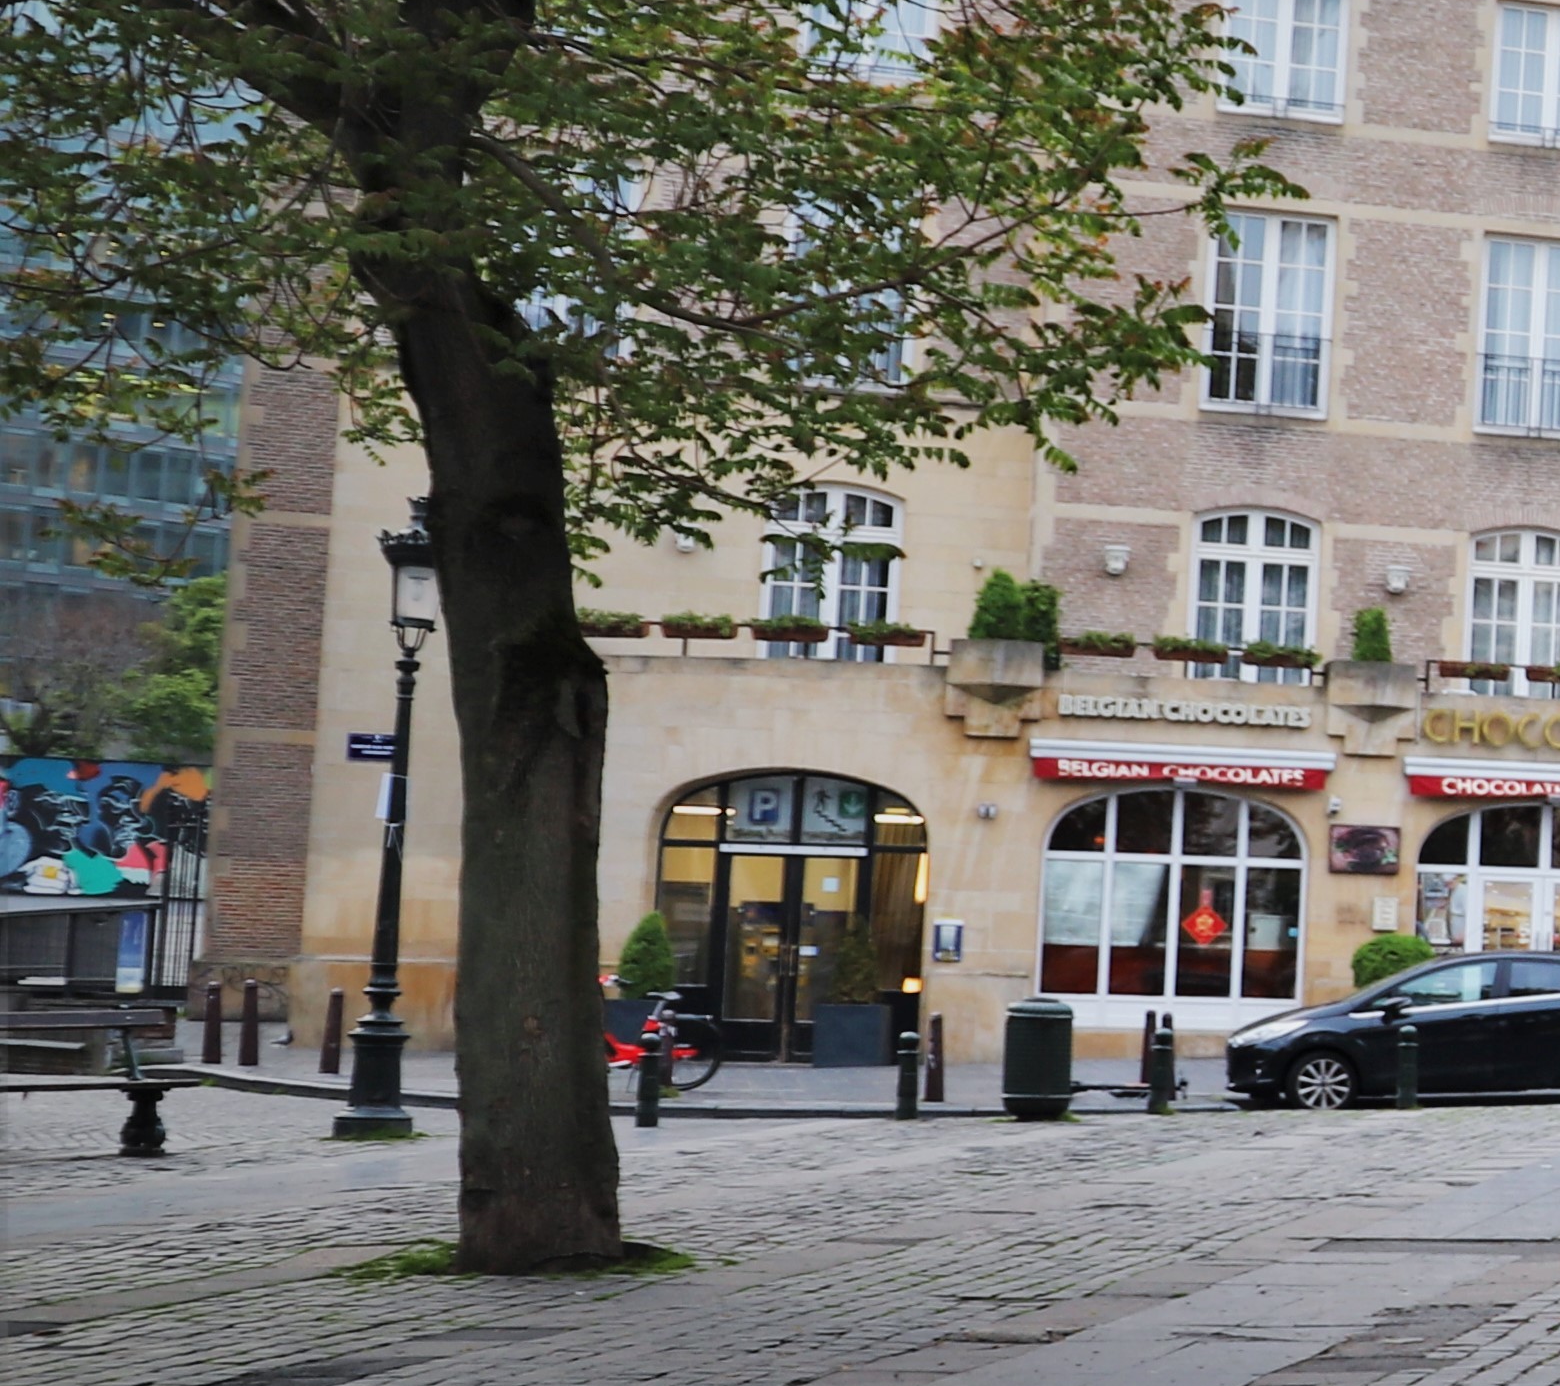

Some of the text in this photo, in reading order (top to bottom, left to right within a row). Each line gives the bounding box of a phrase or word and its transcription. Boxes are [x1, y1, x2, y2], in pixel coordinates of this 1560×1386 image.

[1058, 693, 1312, 729] BELGIAN CHOCOLATES
[1057, 759, 1305, 787] BELGIAN CHOCOLATES
[753, 790, 777, 821] P
